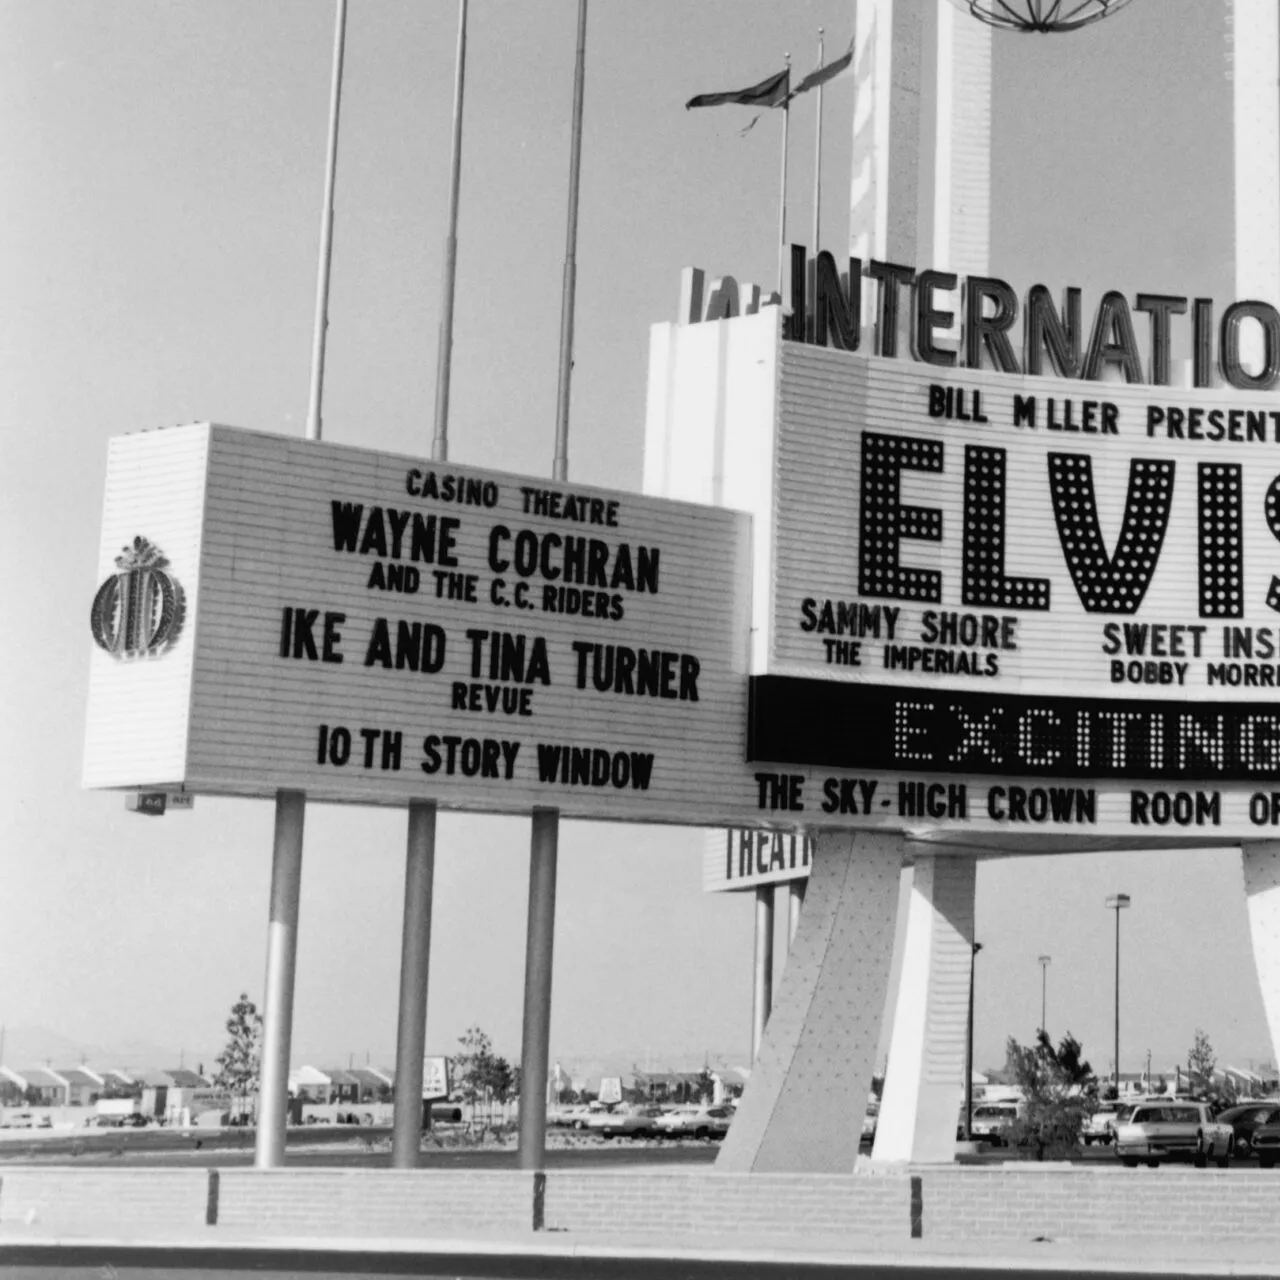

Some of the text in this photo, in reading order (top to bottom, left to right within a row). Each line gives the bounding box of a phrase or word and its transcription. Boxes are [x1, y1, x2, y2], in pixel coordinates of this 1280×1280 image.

[928, 384, 988, 422] BILL
[405, 468, 620, 528] CASINO THEATRE
[331, 500, 660, 594] WAYNE COCHRAN
[367, 561, 625, 621] AND THE C.C. RIDERS
[800, 597, 1018, 650] SAMMY SHORE
[1102, 623, 1206, 658] SWEET
[280, 607, 700, 702] IKE AND TINA TURNER
[822, 638, 999, 677] THE IMPERIALS
[1110, 660, 1189, 686] BOBBY
[452, 682, 534, 716] REVUE
[421, 735, 520, 780] STORY
[537, 744, 655, 790] WINDOW
[755, 773, 805, 812] THE
[987, 787, 1096, 823] CROWN
[1130, 790, 1221, 826] ROOM
